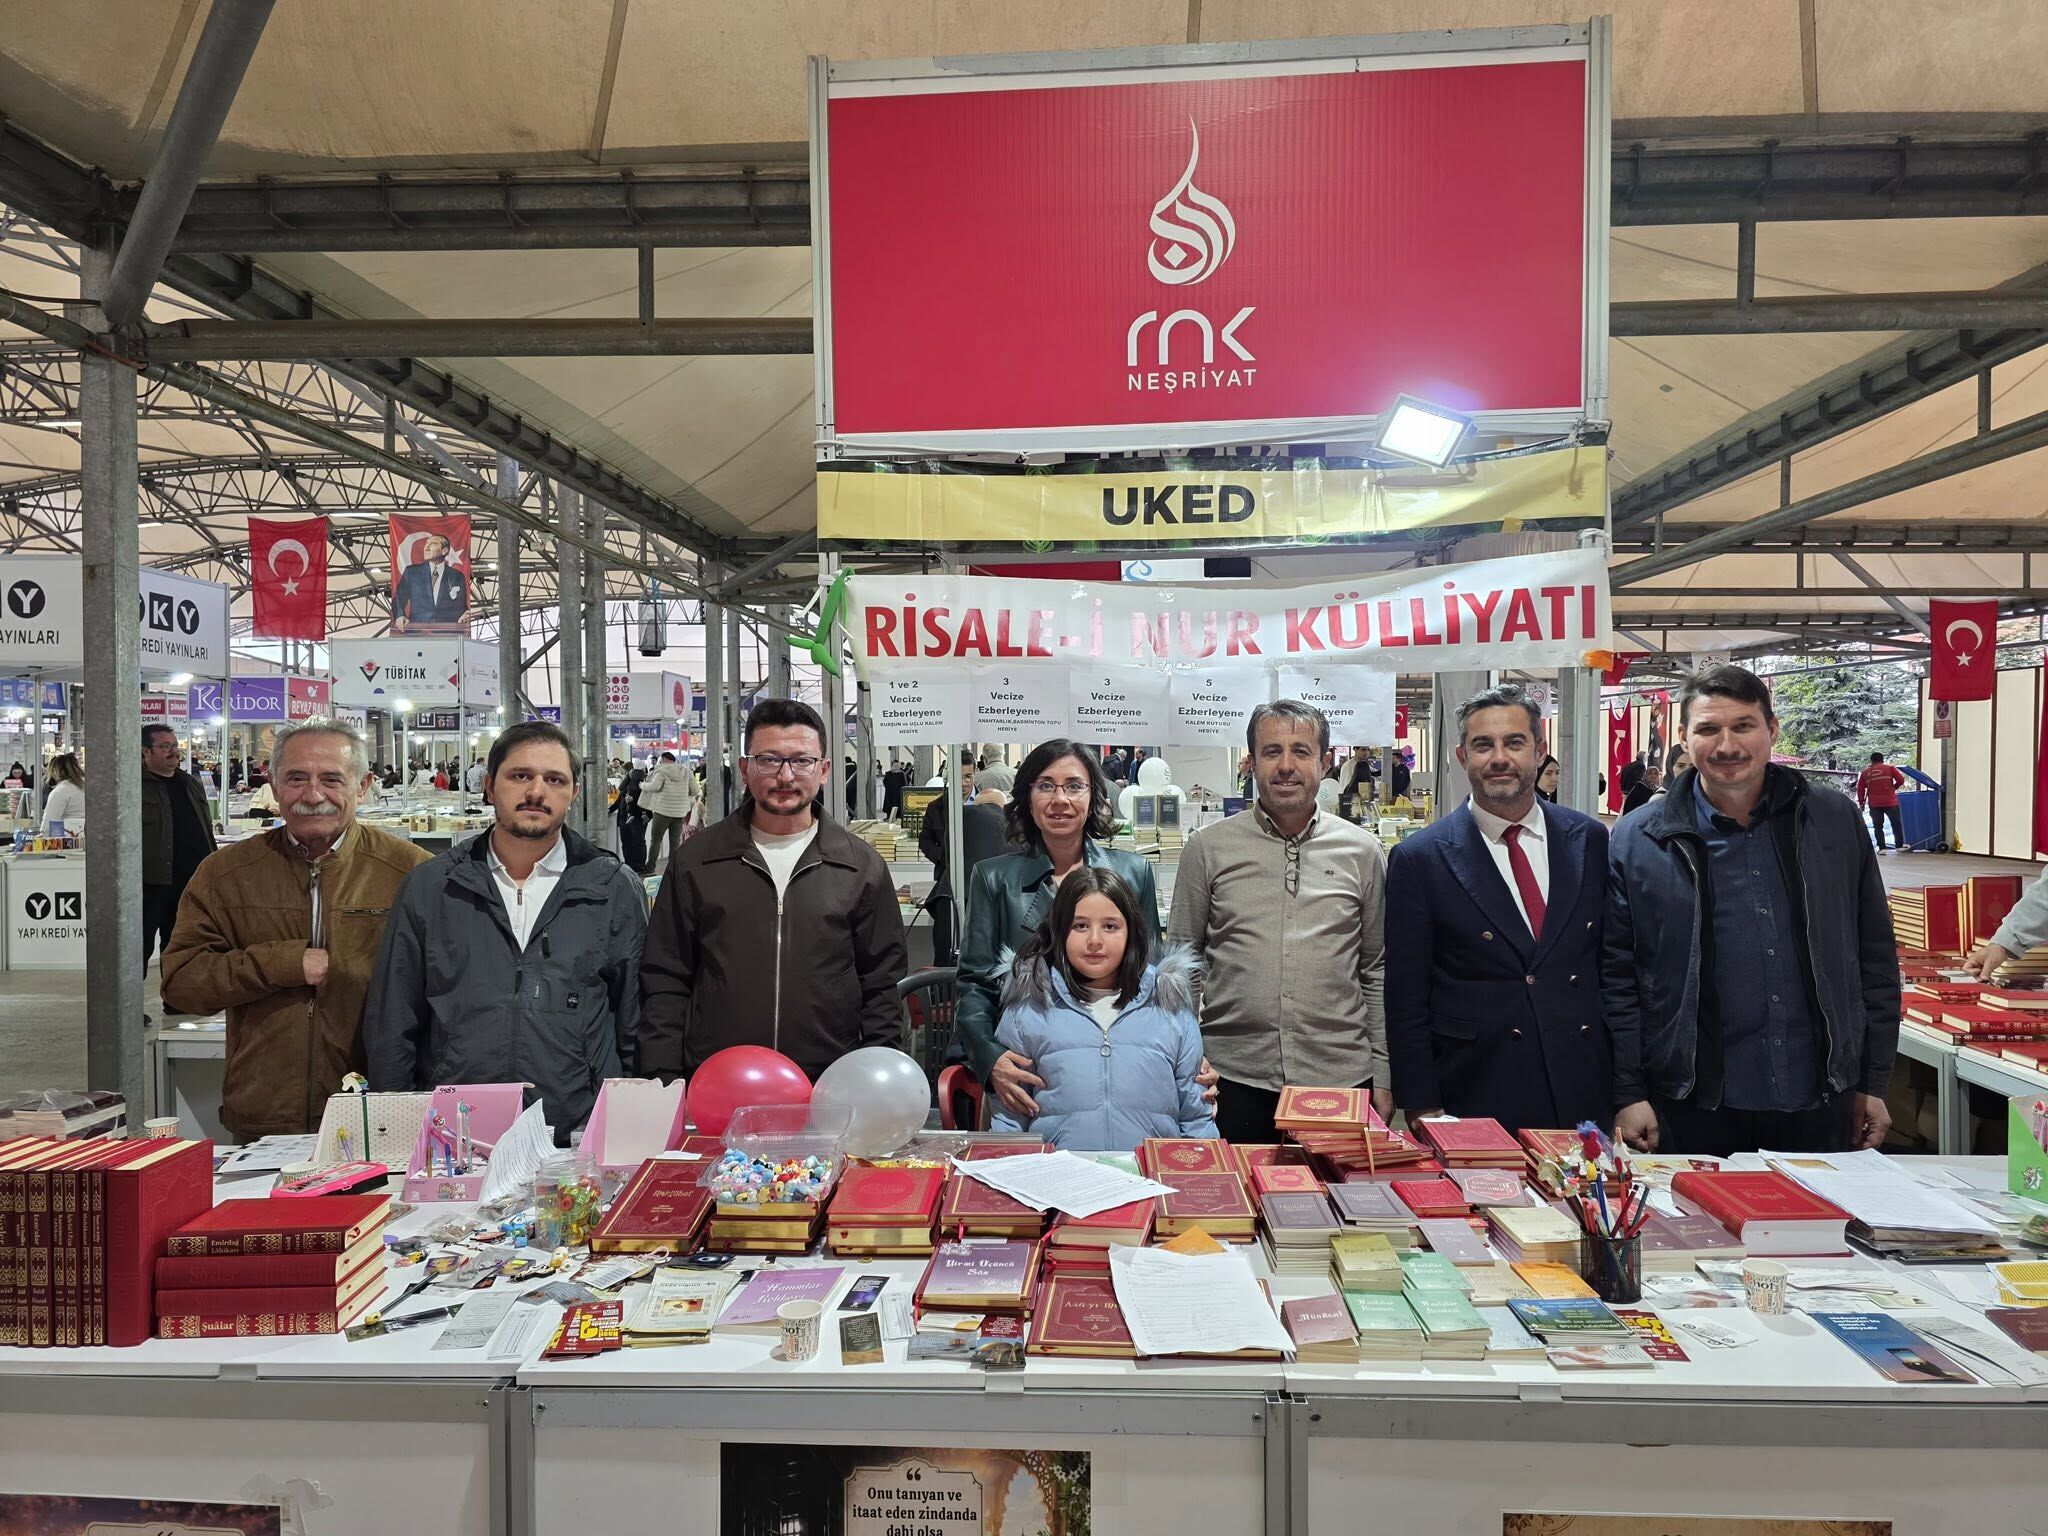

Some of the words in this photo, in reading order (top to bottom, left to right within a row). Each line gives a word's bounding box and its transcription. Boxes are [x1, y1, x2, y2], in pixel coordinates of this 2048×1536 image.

[1128, 367, 1257, 393] NEŞRİYAT
[1102, 485, 1255, 525] UKED
[1130, 609, 1262, 658] NUR
[1285, 581, 1596, 652] KÜLLİYATI
[0, 630, 60, 645] AYINLARI
[141, 637, 164, 654] REDİ
[165, 641, 209, 661] YAYINLARI
[384, 665, 426, 680] TÜBİTAK
[889, 681, 895, 689] 1
[912, 680, 919, 688] 2
[1003, 677, 1010, 686] 3
[1104, 678, 1111, 686] 3
[1205, 678, 1212, 687] 5
[1314, 678, 1320, 686] 7
[890, 694, 922, 704] Vecize
[990, 691, 1024, 701] Vecize
[1091, 692, 1126, 701] Vecize
[1192, 692, 1228, 702] Vecize
[1300, 692, 1337, 701] Vecize
[291, 700, 312, 715] BEYAZ
[978, 706, 1041, 717] Ezberleyene
[1077, 706, 1142, 717] Ezberleyene
[1178, 706, 1244, 718] Ezberleyene
[1319, 708, 1354, 717] leyene
[882, 708, 942, 719] Ezberleyene
[18, 928, 39, 939] YAPI
[42, 925, 71, 939] KREDİ
[867, 1487, 893, 1499] Onu
[896, 1488, 944, 1502] tanıyan
[948, 1490, 962, 1501] ve
[852, 1504, 883, 1519] itaat
[885, 1506, 916, 1520] eden
[919, 1507, 977, 1522] zindanda
[886, 1525, 914, 1536] dahi
[917, 1526, 943, 1536] olsa
